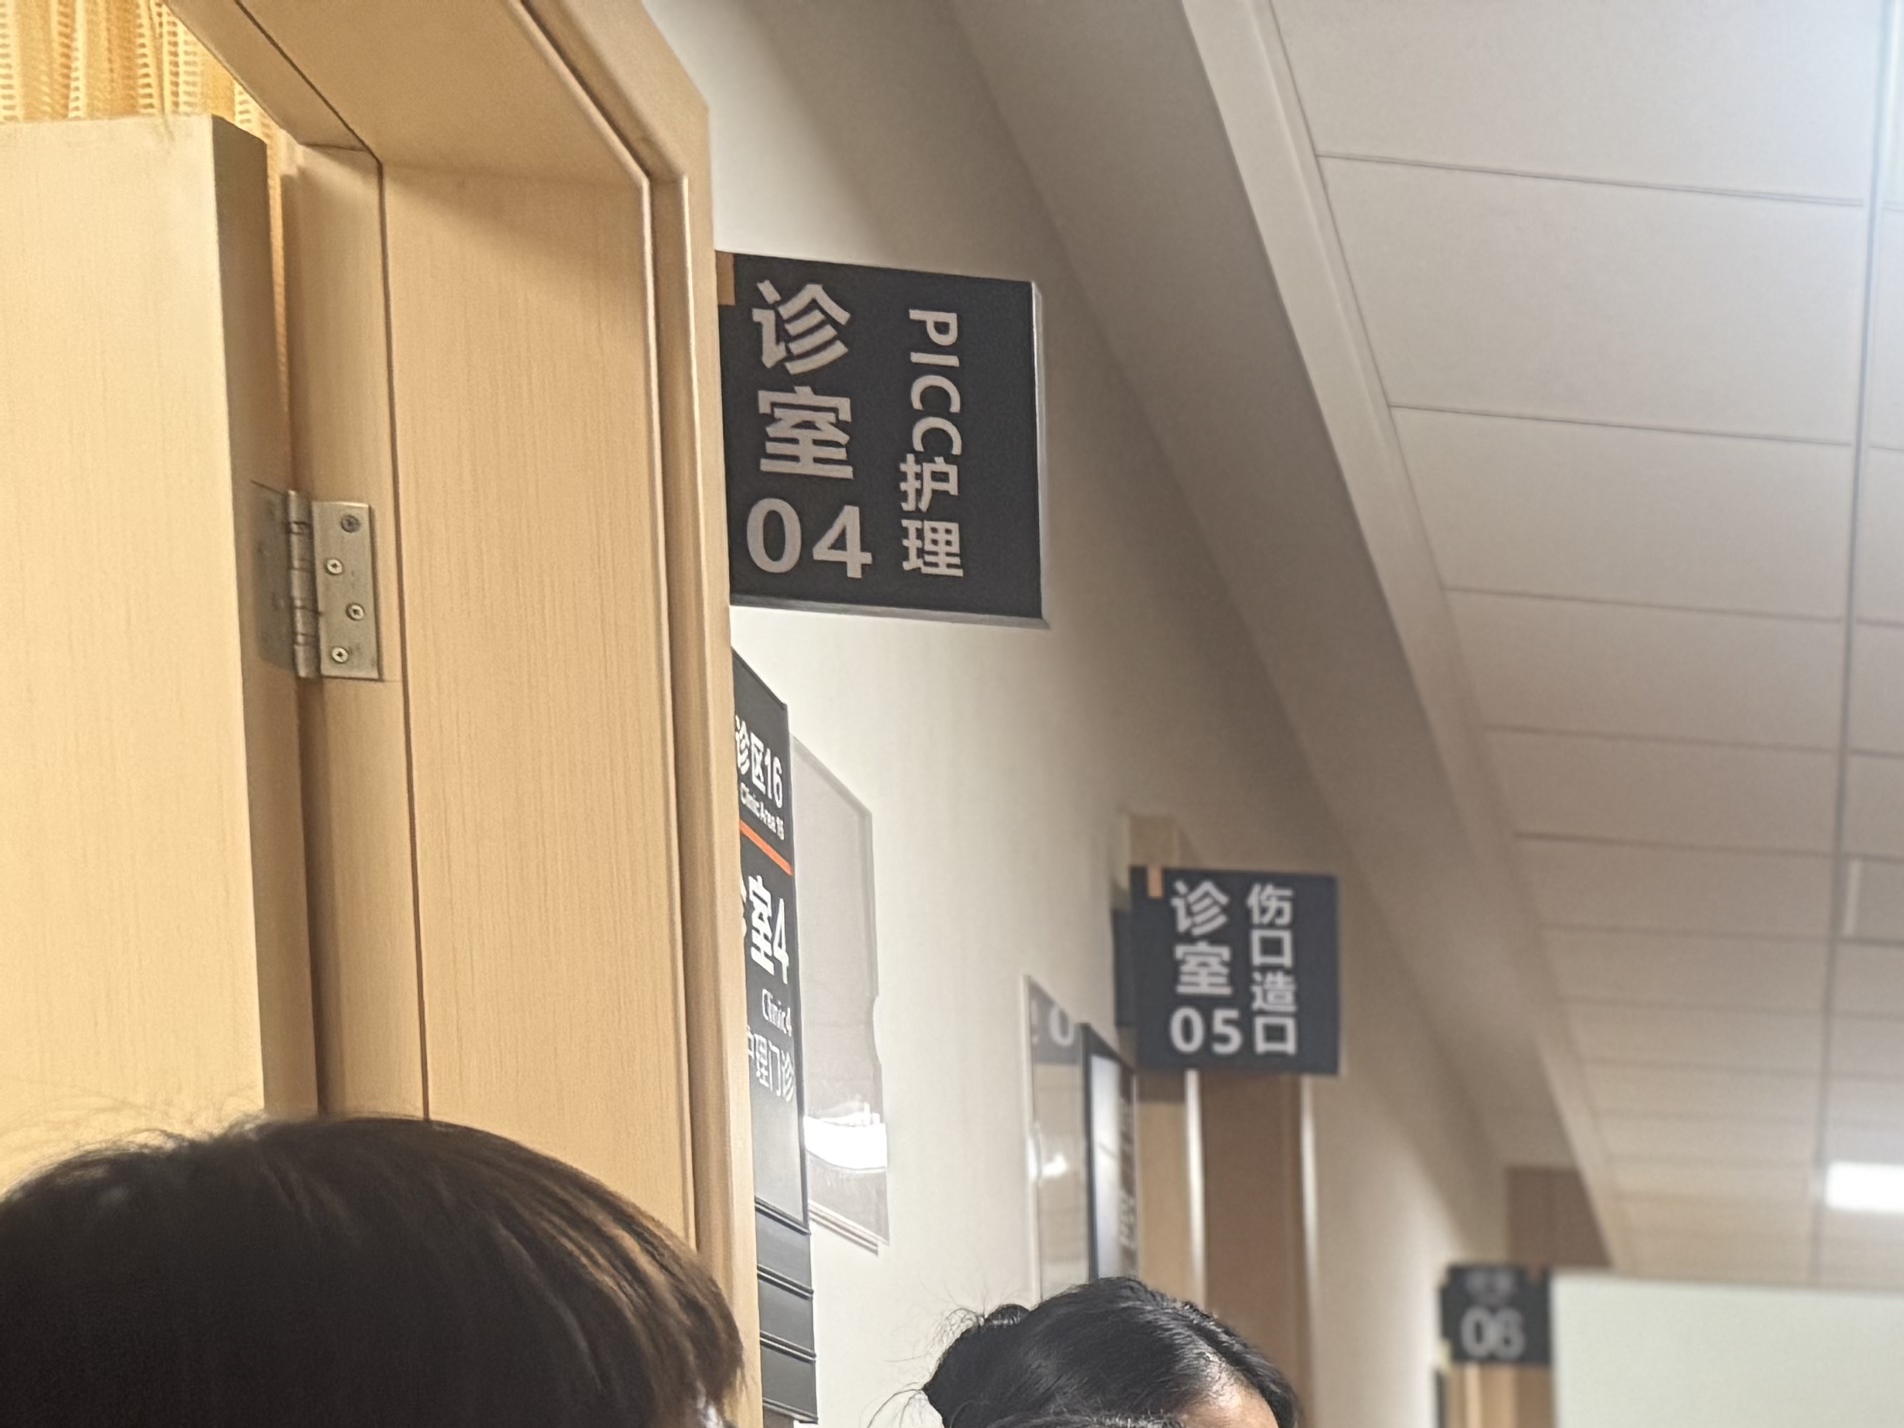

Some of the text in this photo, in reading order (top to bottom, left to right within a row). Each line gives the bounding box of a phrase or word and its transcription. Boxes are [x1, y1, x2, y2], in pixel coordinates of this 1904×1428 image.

[752, 280, 854, 479] 诊室
[900, 308, 964, 577] PICC护理
[746, 498, 873, 579] 04
[735, 715, 783, 809] 诊区16
[741, 875, 789, 984] 室4
[1170, 880, 1234, 997] 诊室
[1247, 884, 1298, 1056] 伤口造口
[1170, 1008, 1243, 1056] 05
[1461, 1304, 1525, 1359] 06
